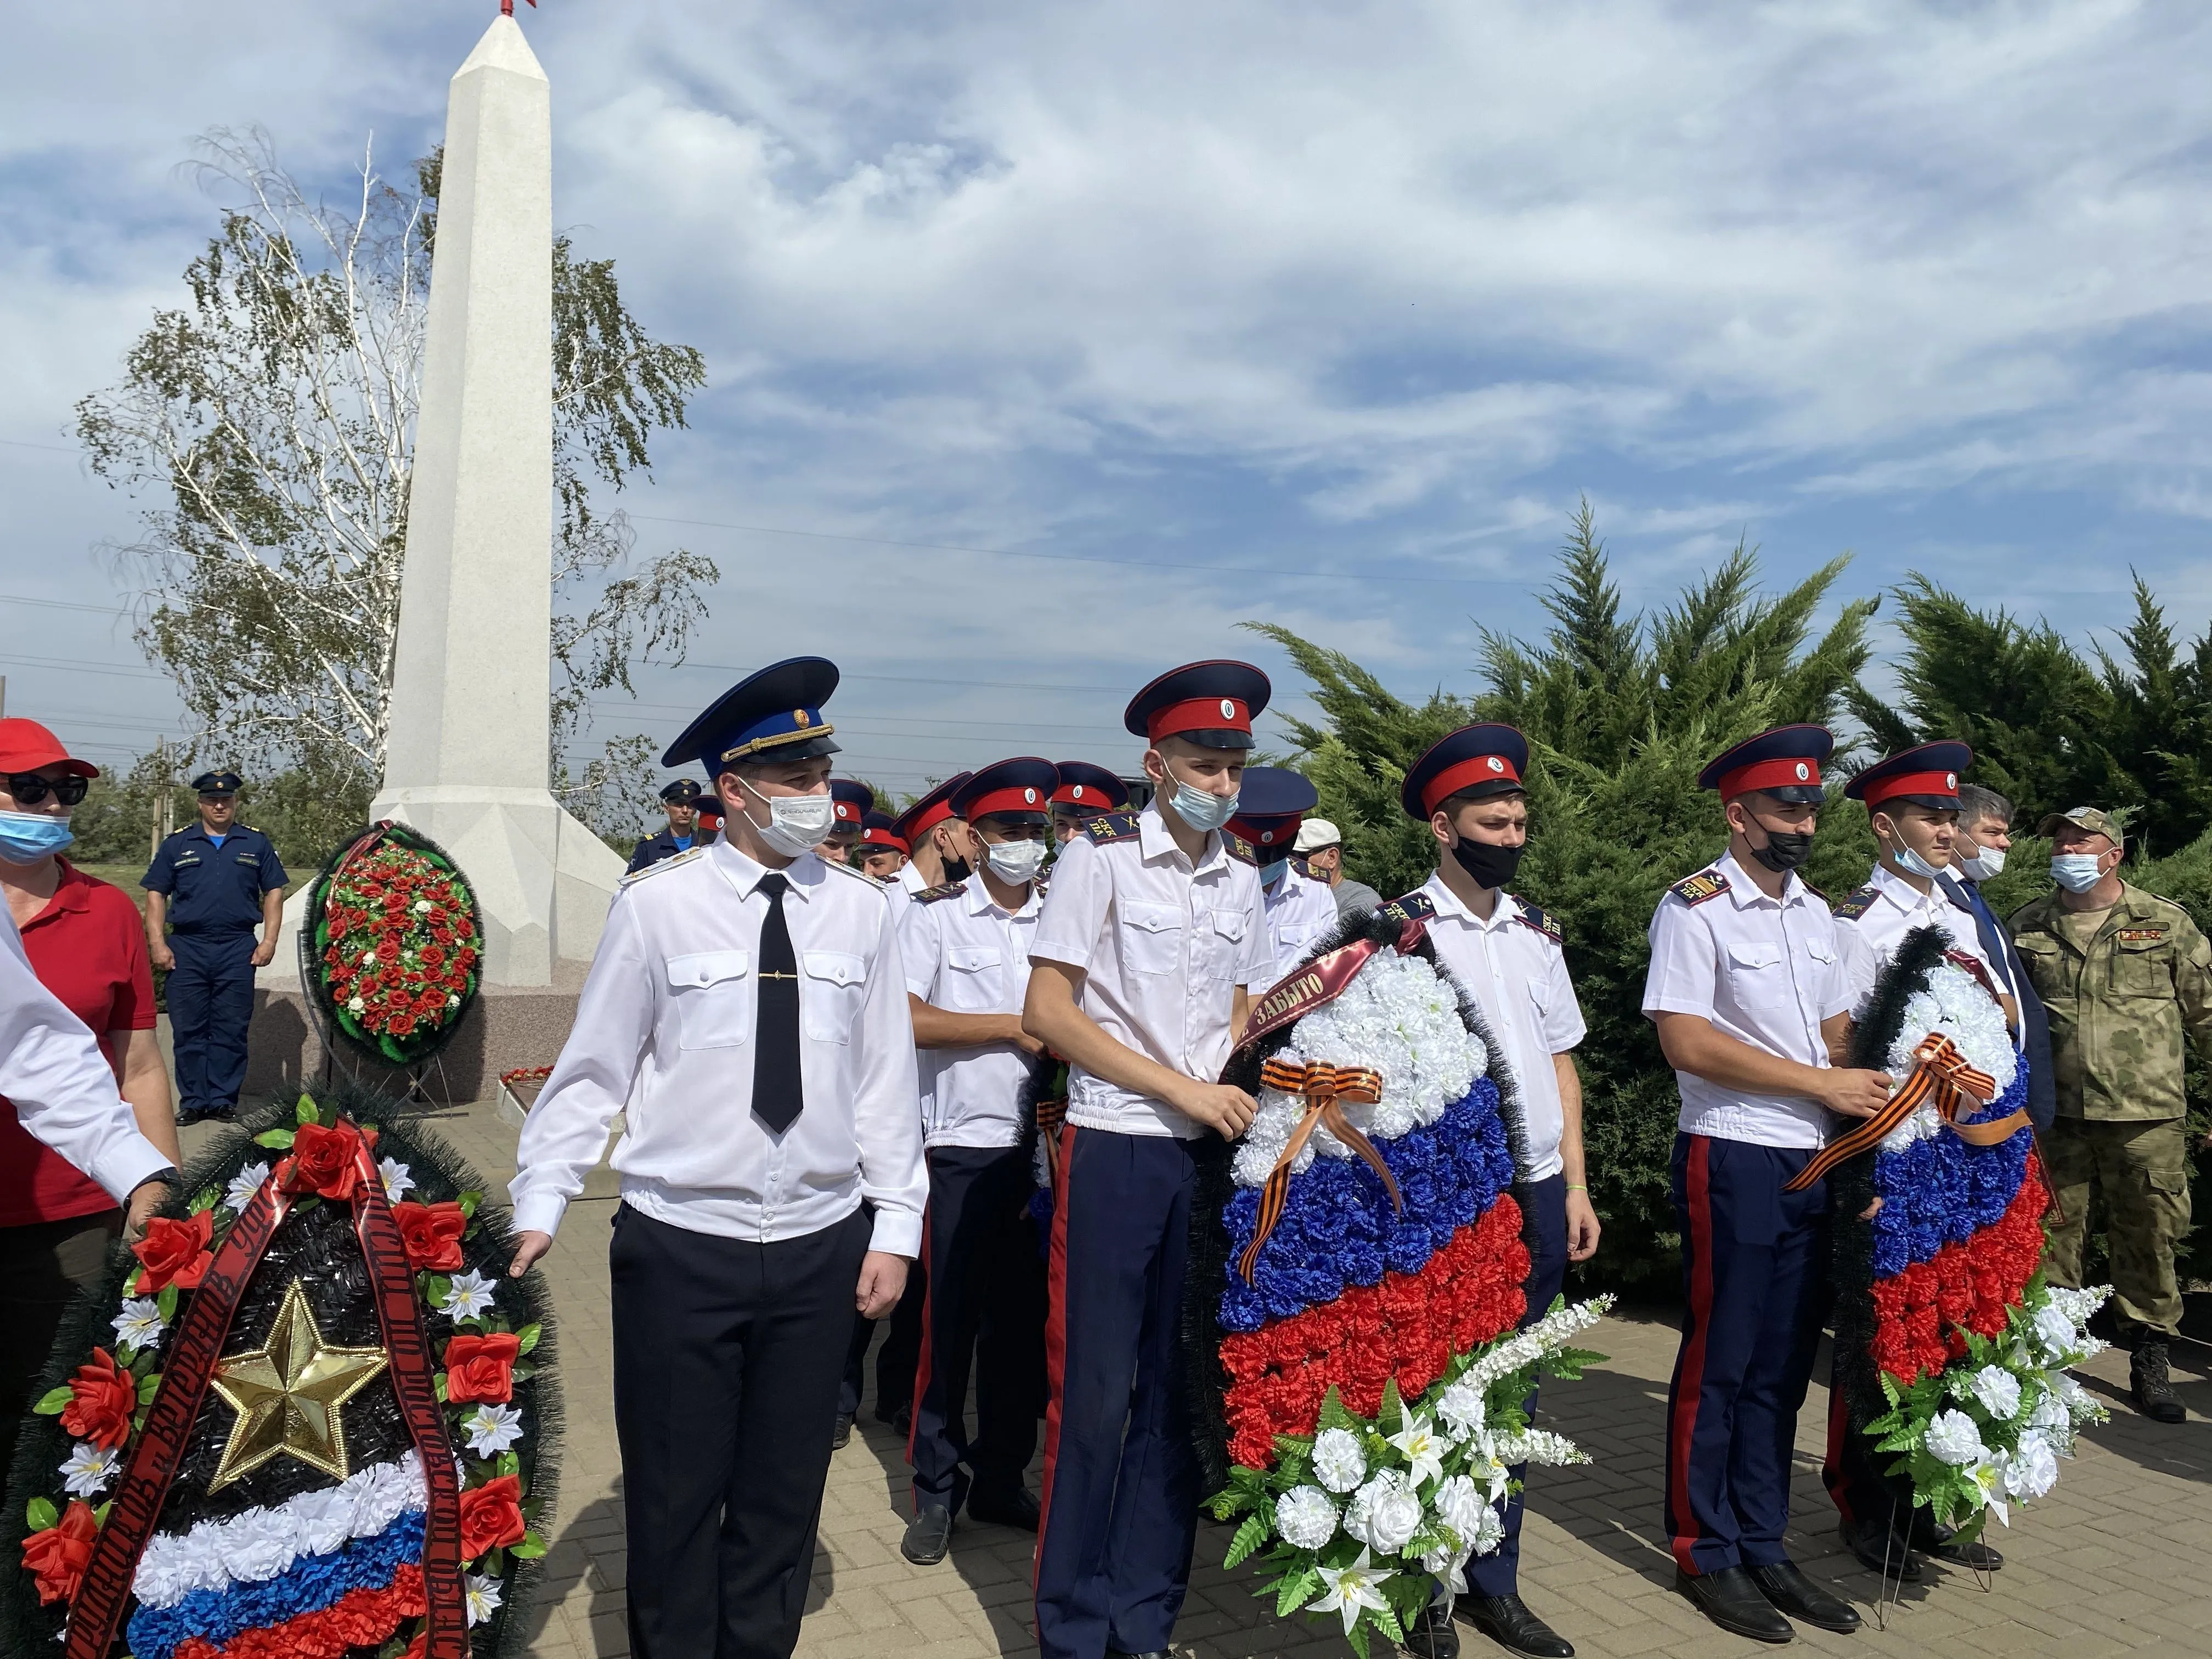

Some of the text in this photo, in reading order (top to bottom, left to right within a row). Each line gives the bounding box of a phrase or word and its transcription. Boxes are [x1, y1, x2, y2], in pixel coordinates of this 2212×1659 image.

[1684, 882, 1706, 898] СКК
[1254, 973, 1324, 1025] ЗАБЫТО
[229, 1173, 281, 1257] УФС
[386, 1318, 424, 1355] ПО
[425, 1558, 465, 1659] ОБЛАС
